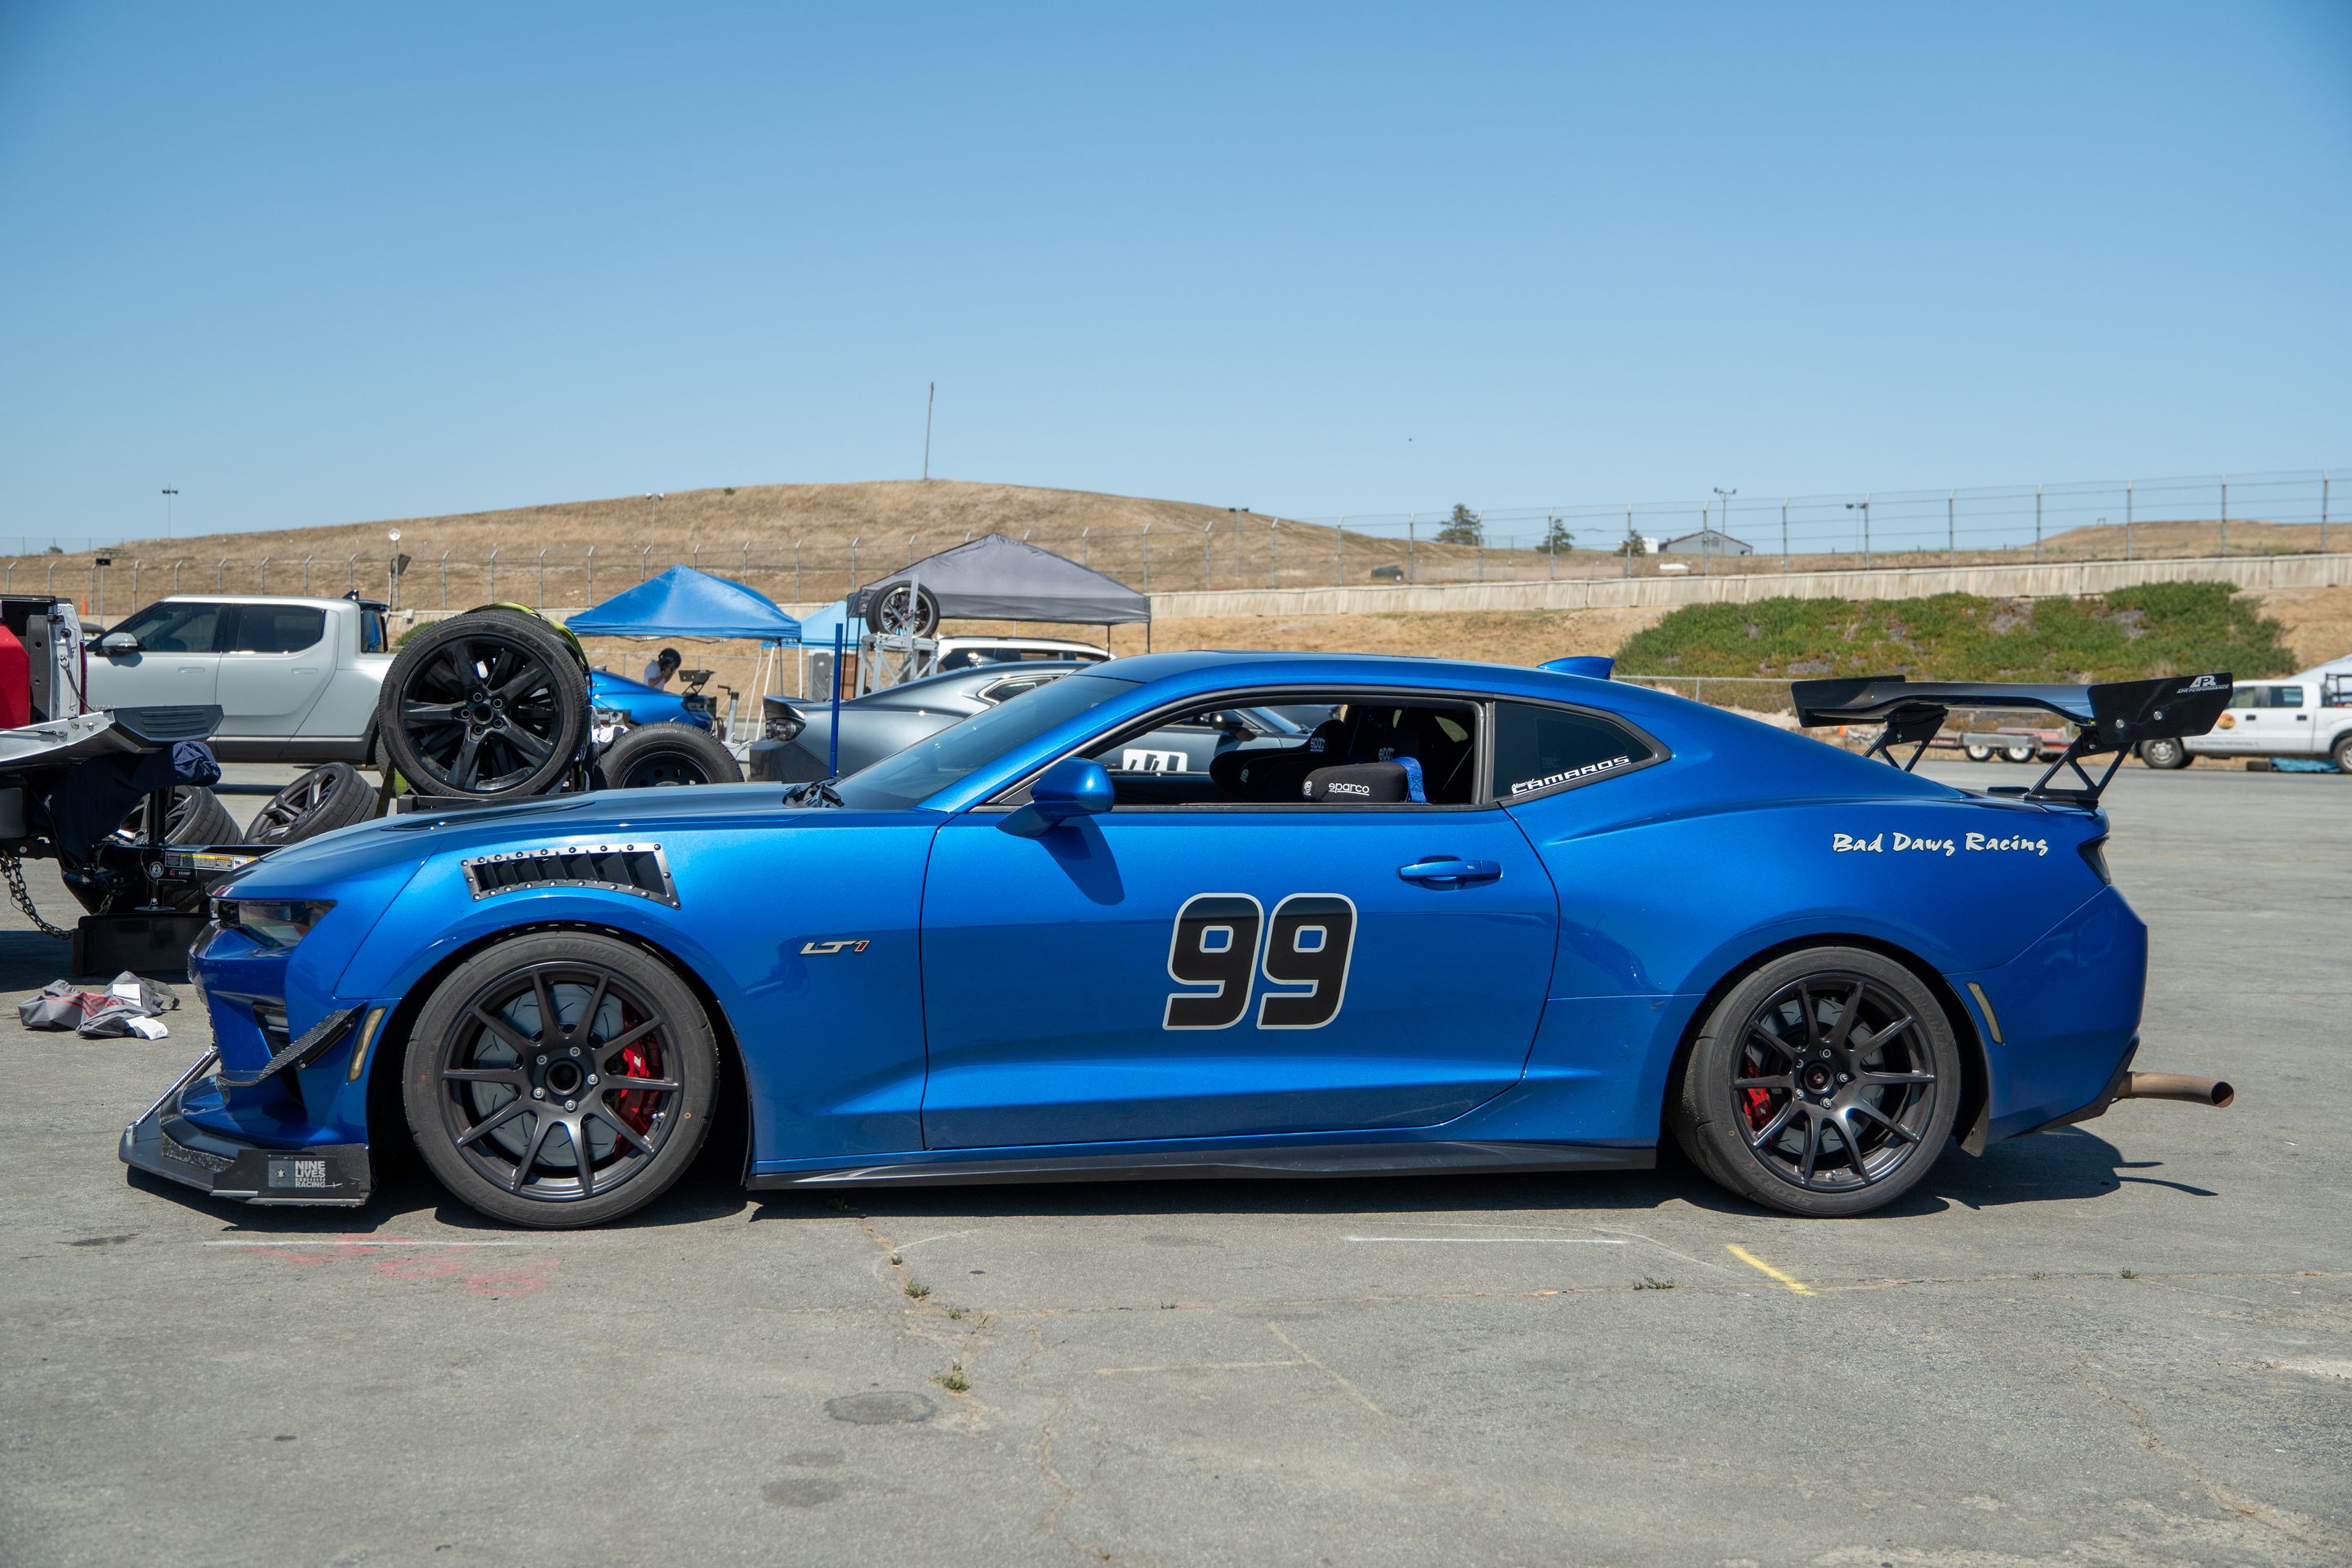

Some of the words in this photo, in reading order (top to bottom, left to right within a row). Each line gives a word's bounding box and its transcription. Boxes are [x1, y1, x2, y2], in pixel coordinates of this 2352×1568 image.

[2189, 684, 2230, 693] PERFORMANCE
[1511, 756, 1630, 795] CAMAROS
[1328, 782, 1370, 795] sparco
[1832, 832, 1884, 853] Bad
[1891, 831, 1955, 857] Dawg
[1965, 831, 2048, 857] Racing
[800, 940, 870, 954] LT1
[1162, 893, 1357, 1030] 99
[295, 1160, 326, 1170] NINE
[295, 1169, 326, 1178] LIVES
